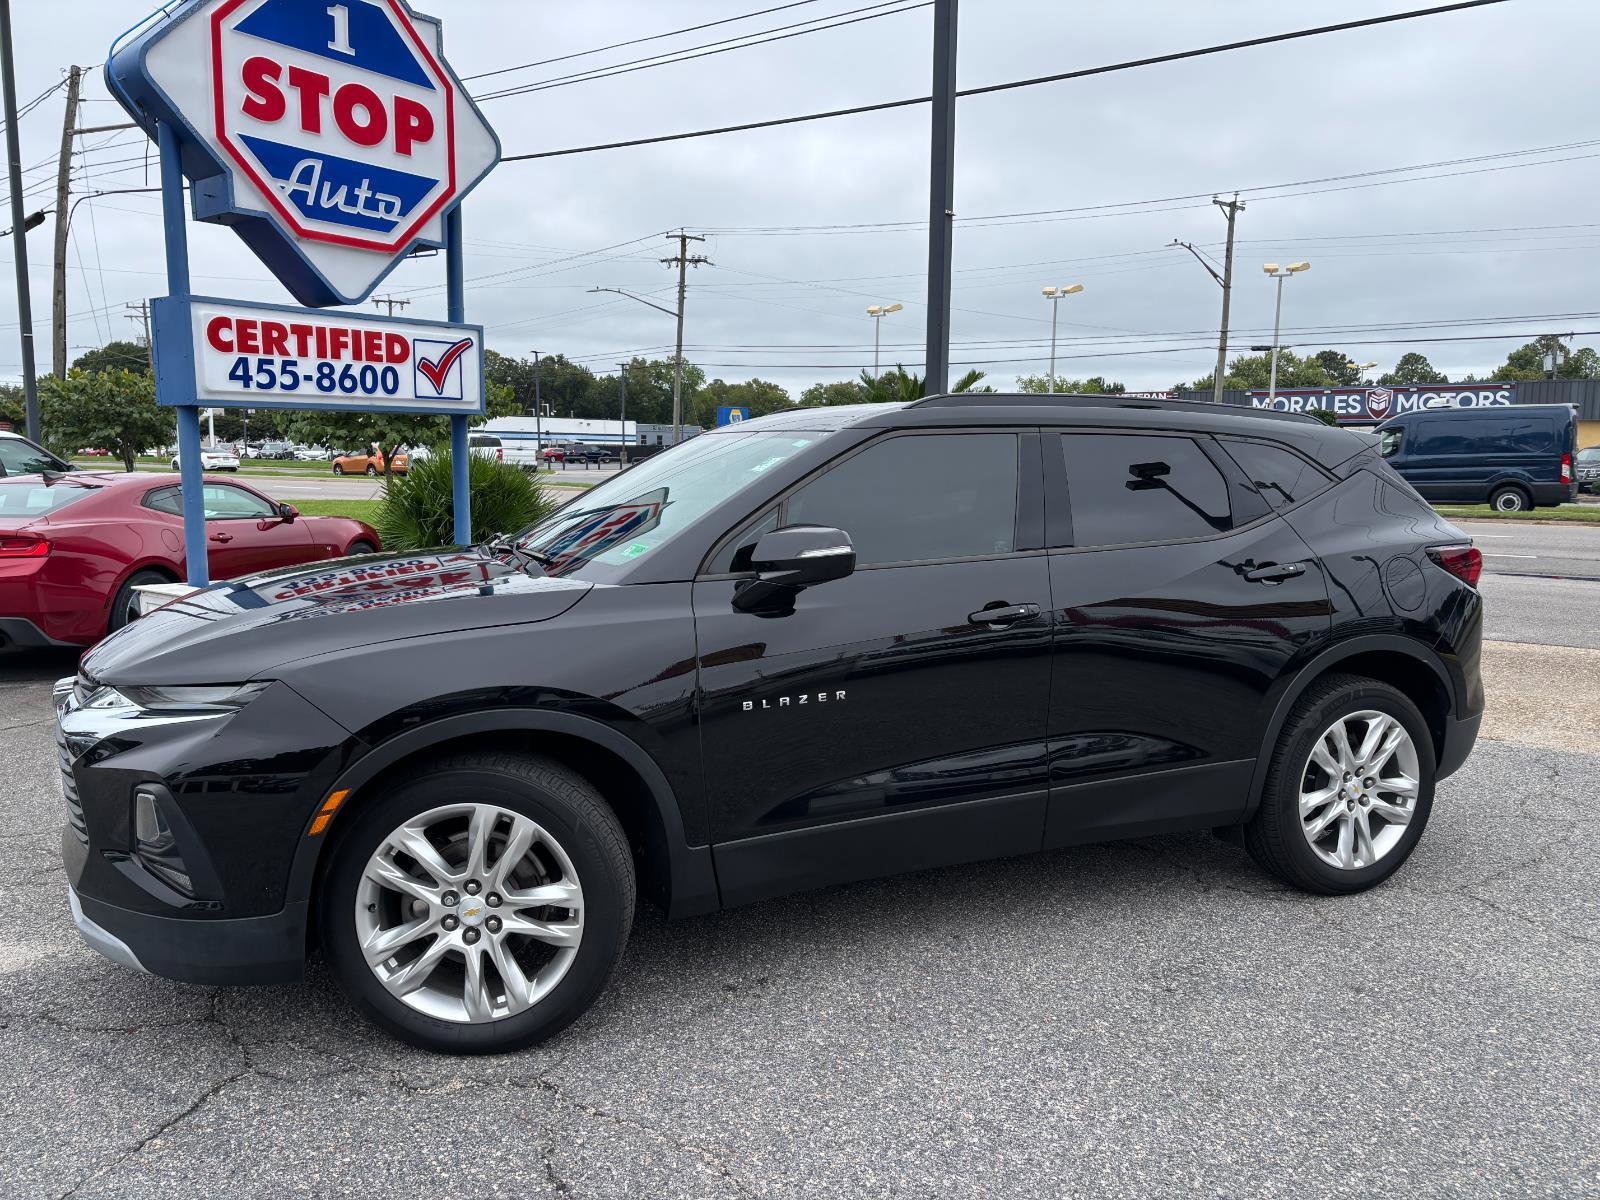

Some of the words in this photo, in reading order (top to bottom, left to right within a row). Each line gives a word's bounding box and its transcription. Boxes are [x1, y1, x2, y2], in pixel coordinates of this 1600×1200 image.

[326, 3, 356, 56] 1
[240, 56, 435, 157] STOP
[271, 158, 402, 220] Auto
[206, 315, 411, 365] CERTIFIED
[228, 356, 400, 395] 455-8600
[1116, 392, 1167, 400] ERAN
[1252, 395, 1361, 414] MORALES
[1396, 391, 1510, 413] MOTORS
[742, 690, 846, 711] BLAZER
